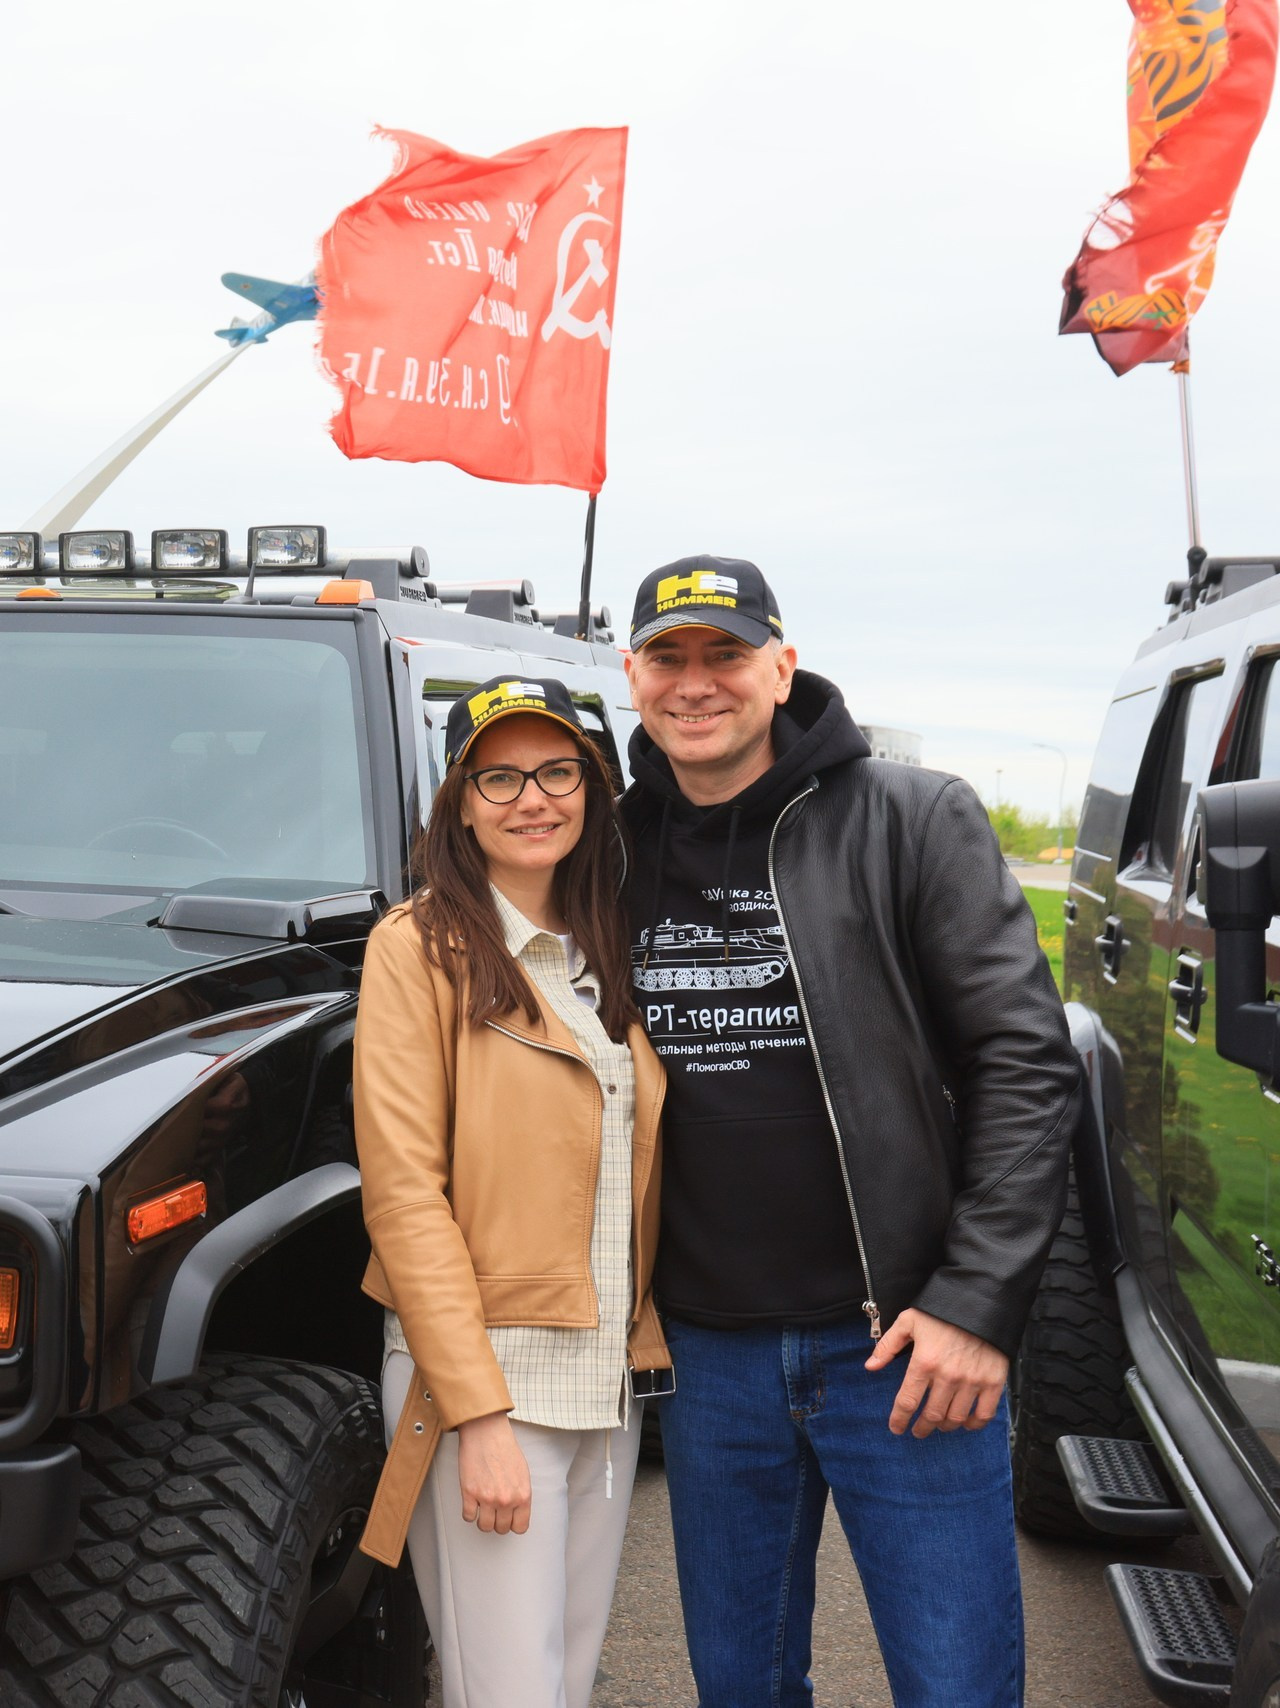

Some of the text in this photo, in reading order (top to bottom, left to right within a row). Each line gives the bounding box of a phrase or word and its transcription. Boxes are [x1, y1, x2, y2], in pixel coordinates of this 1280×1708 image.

[657, 571, 738, 603] H2
[657, 594, 737, 613] HUMMER
[468, 681, 546, 719] H2
[472, 698, 547, 727] HUMMER
[754, 890, 773, 900] 2С
[729, 901, 776, 912] ВОЗДИКА
[640, 1005, 800, 1035] РТ-терапия
[657, 1037, 806, 1056] кальные методы лечения
[686, 1059, 750, 1072] #ПомогаюСВО
